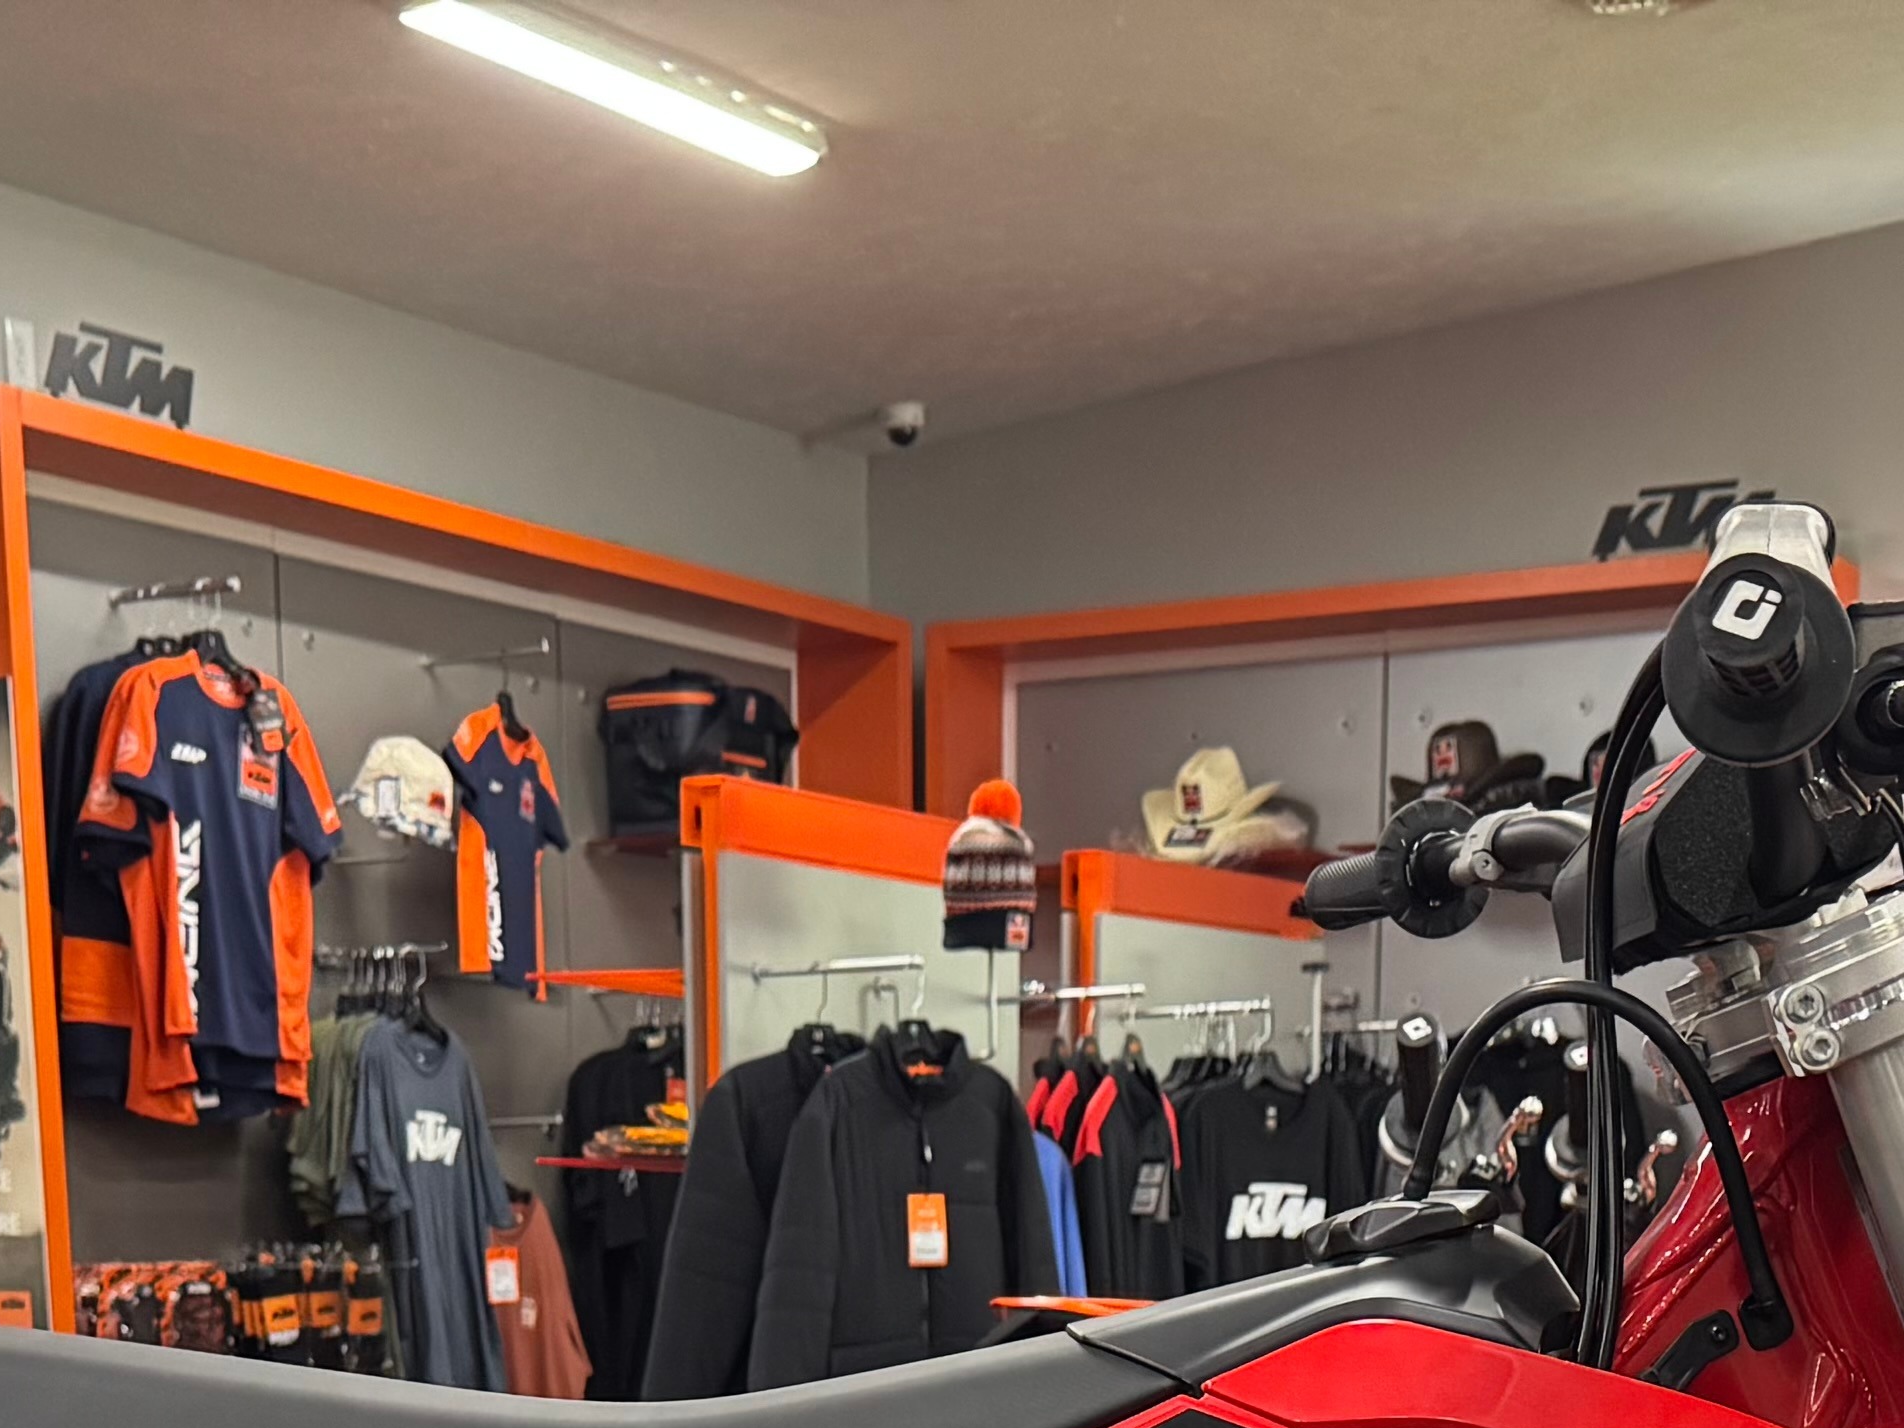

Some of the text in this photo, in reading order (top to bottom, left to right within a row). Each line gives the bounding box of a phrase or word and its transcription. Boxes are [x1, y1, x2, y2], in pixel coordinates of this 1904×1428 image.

[44, 322, 195, 426] KTM
[406, 1109, 462, 1166] KTM
[1225, 1182, 1327, 1240] KTM
